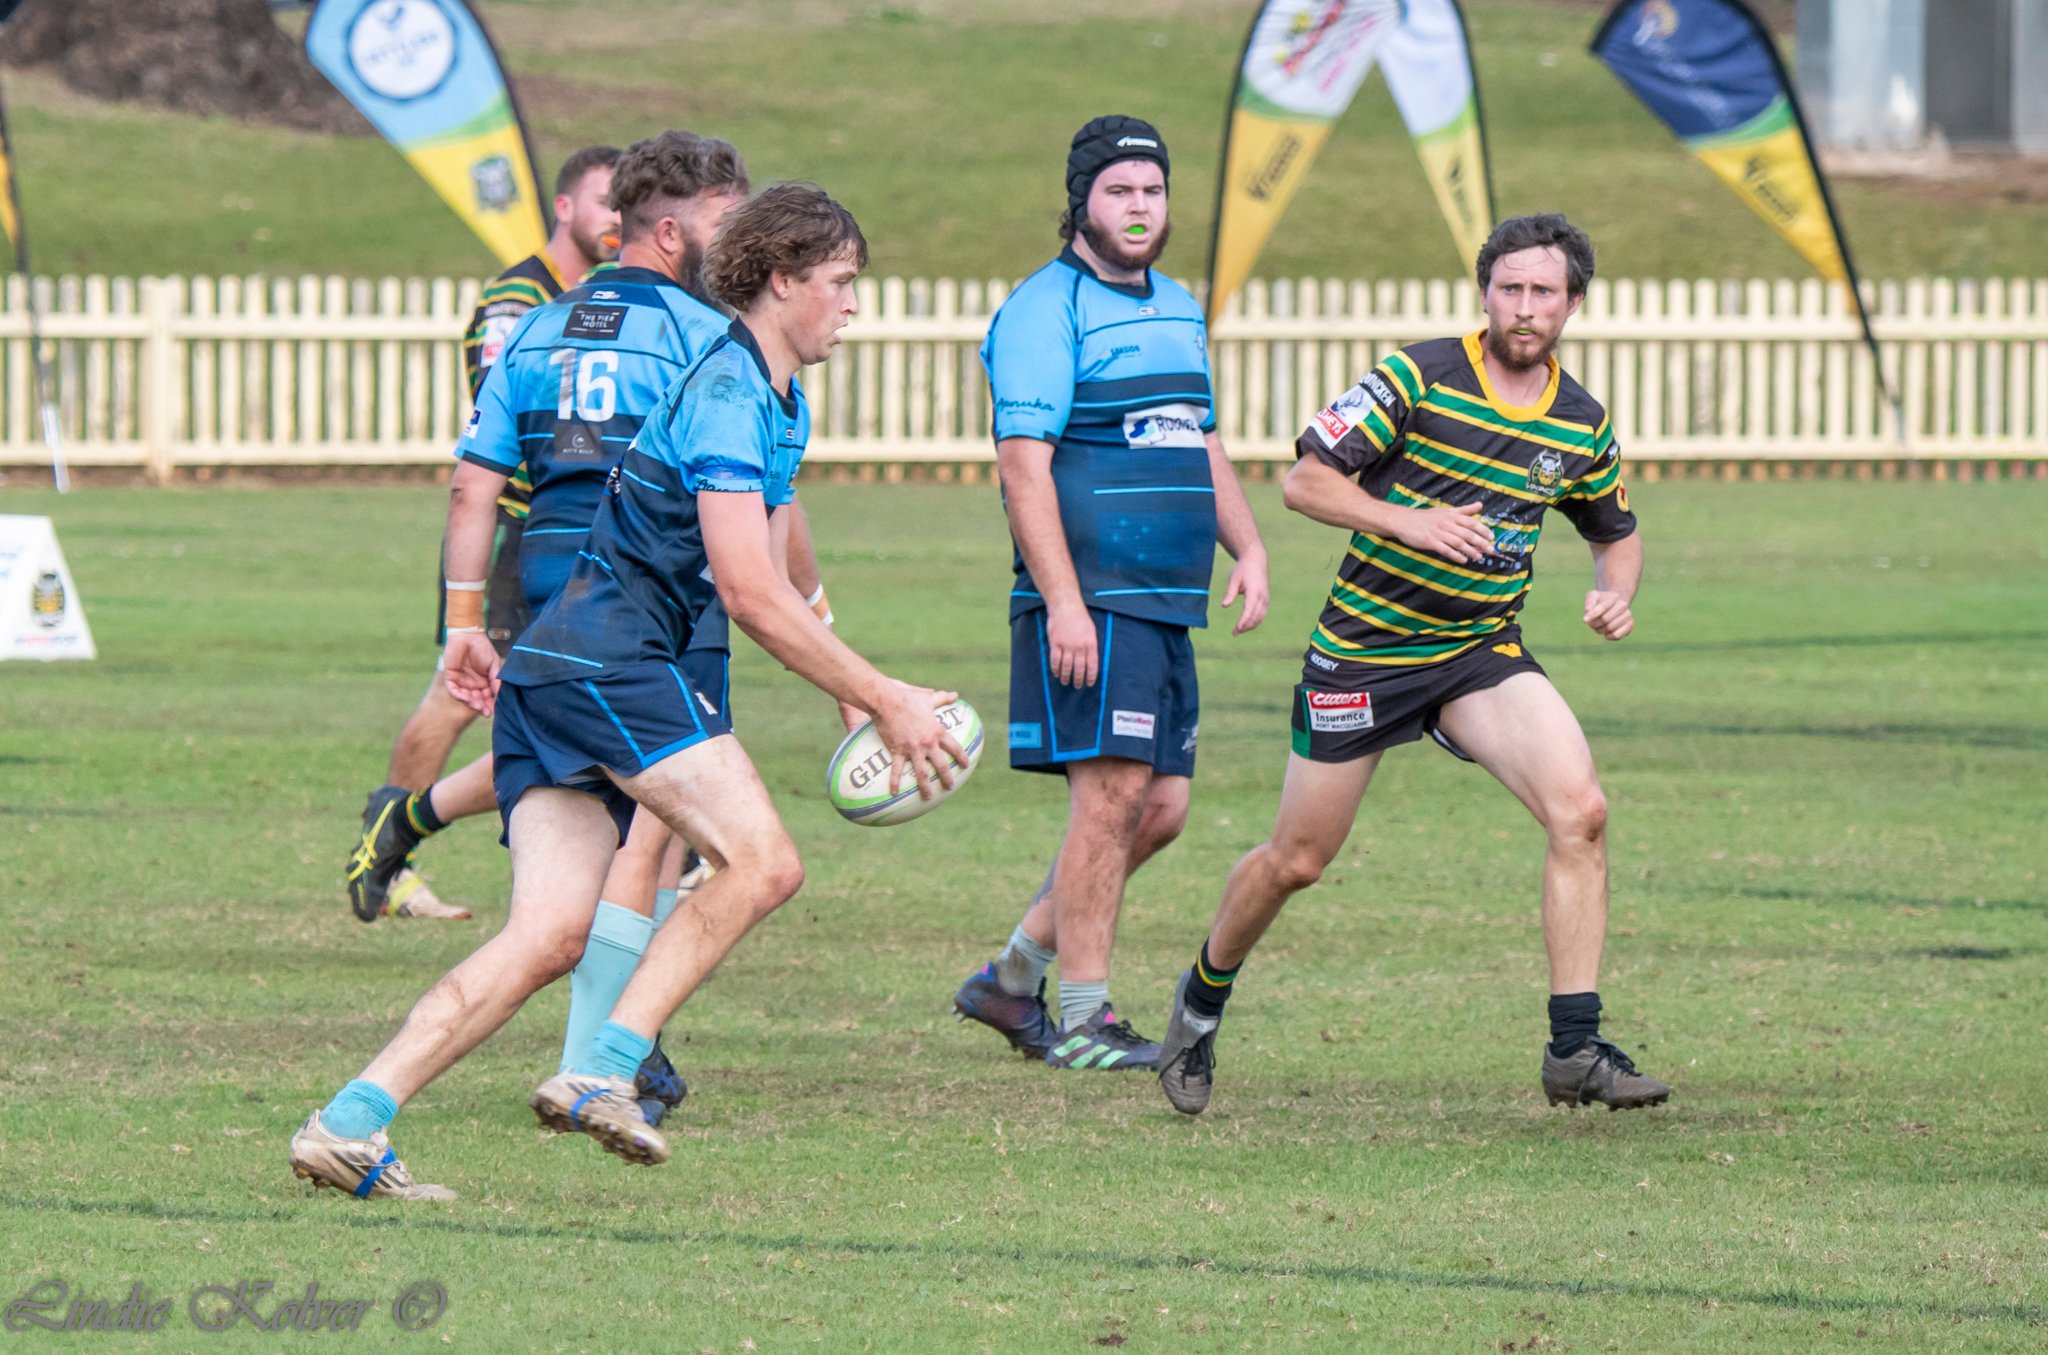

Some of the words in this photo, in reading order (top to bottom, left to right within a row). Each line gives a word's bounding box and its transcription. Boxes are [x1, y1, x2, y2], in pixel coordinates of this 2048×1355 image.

[580, 313, 596, 322] THE
[597, 314, 616, 323] PIER
[582, 321, 608, 329] HOTEL
[549, 348, 619, 422] 16
[1315, 711, 1366, 723] Insurance
[849, 706, 963, 789] GILRT
